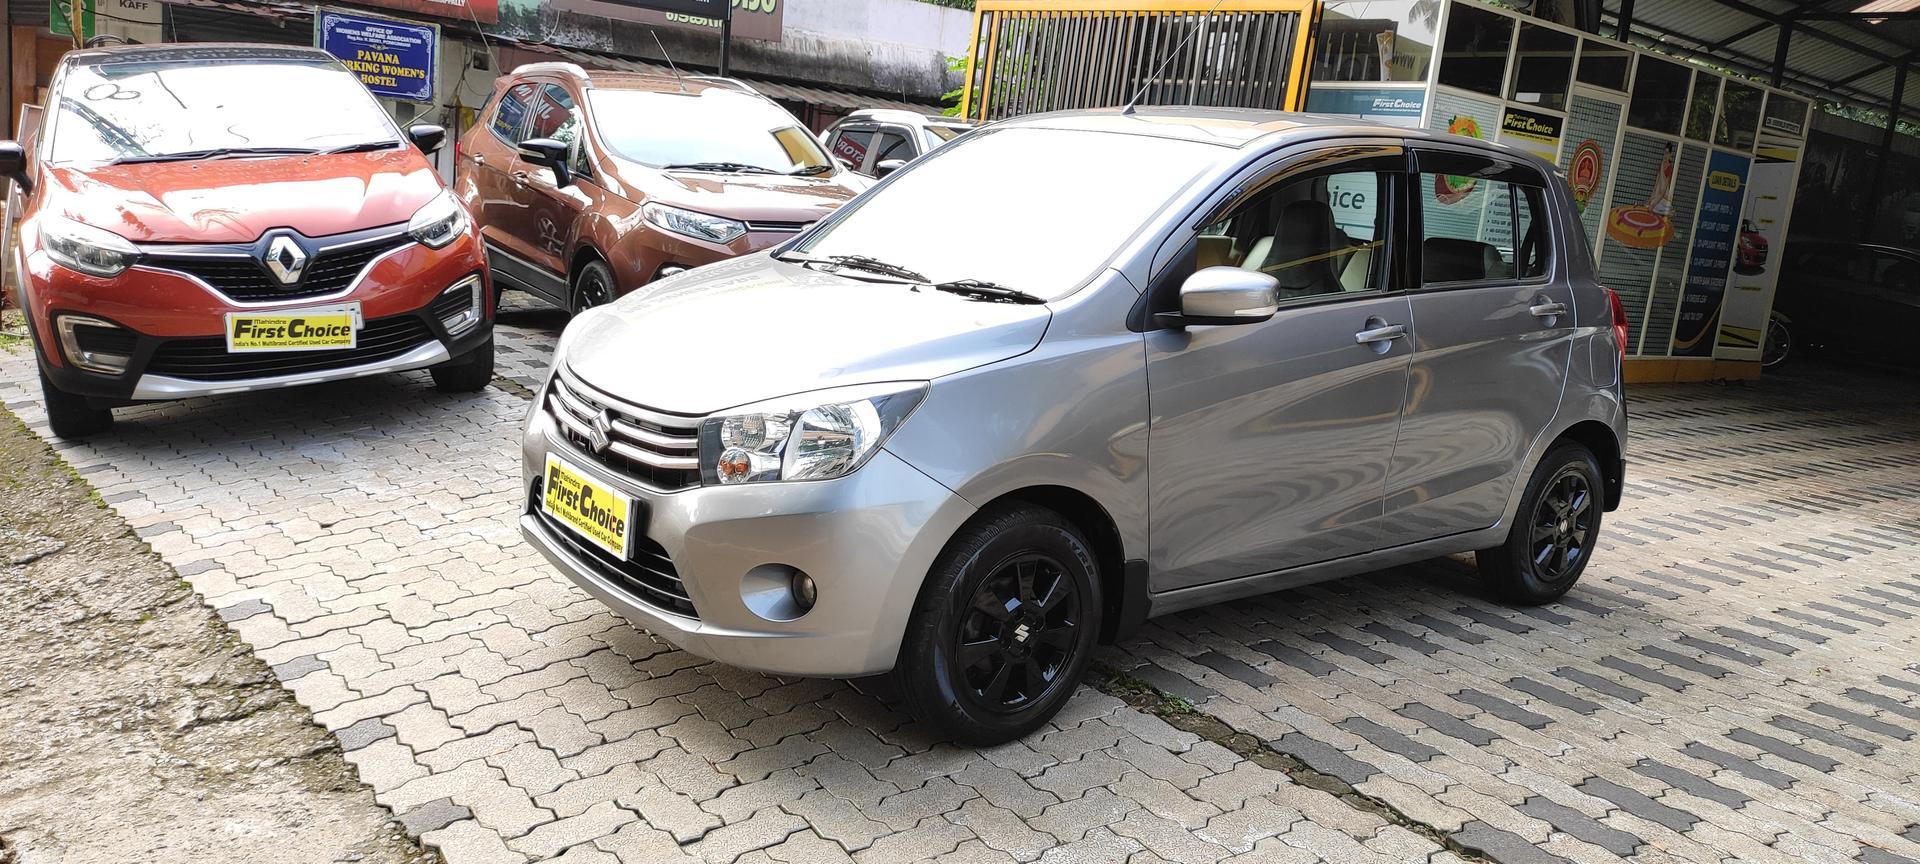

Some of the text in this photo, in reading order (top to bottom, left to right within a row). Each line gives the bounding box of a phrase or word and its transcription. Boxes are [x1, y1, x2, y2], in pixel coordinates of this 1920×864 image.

[119, 0, 149, 11] KAFF
[361, 30, 386, 39] WELFARE
[386, 35, 422, 44] ASSOCIATION
[366, 26, 386, 35] OFFICE
[357, 50, 400, 65] PAVANA
[381, 65, 425, 79] WOMEN'S
[361, 74, 398, 87] HOSTEL
[1503, 113, 1554, 134] First Choice
[1332, 185, 1366, 210] ice
[234, 319, 351, 338] First Choice
[547, 465, 625, 538] First Choice
